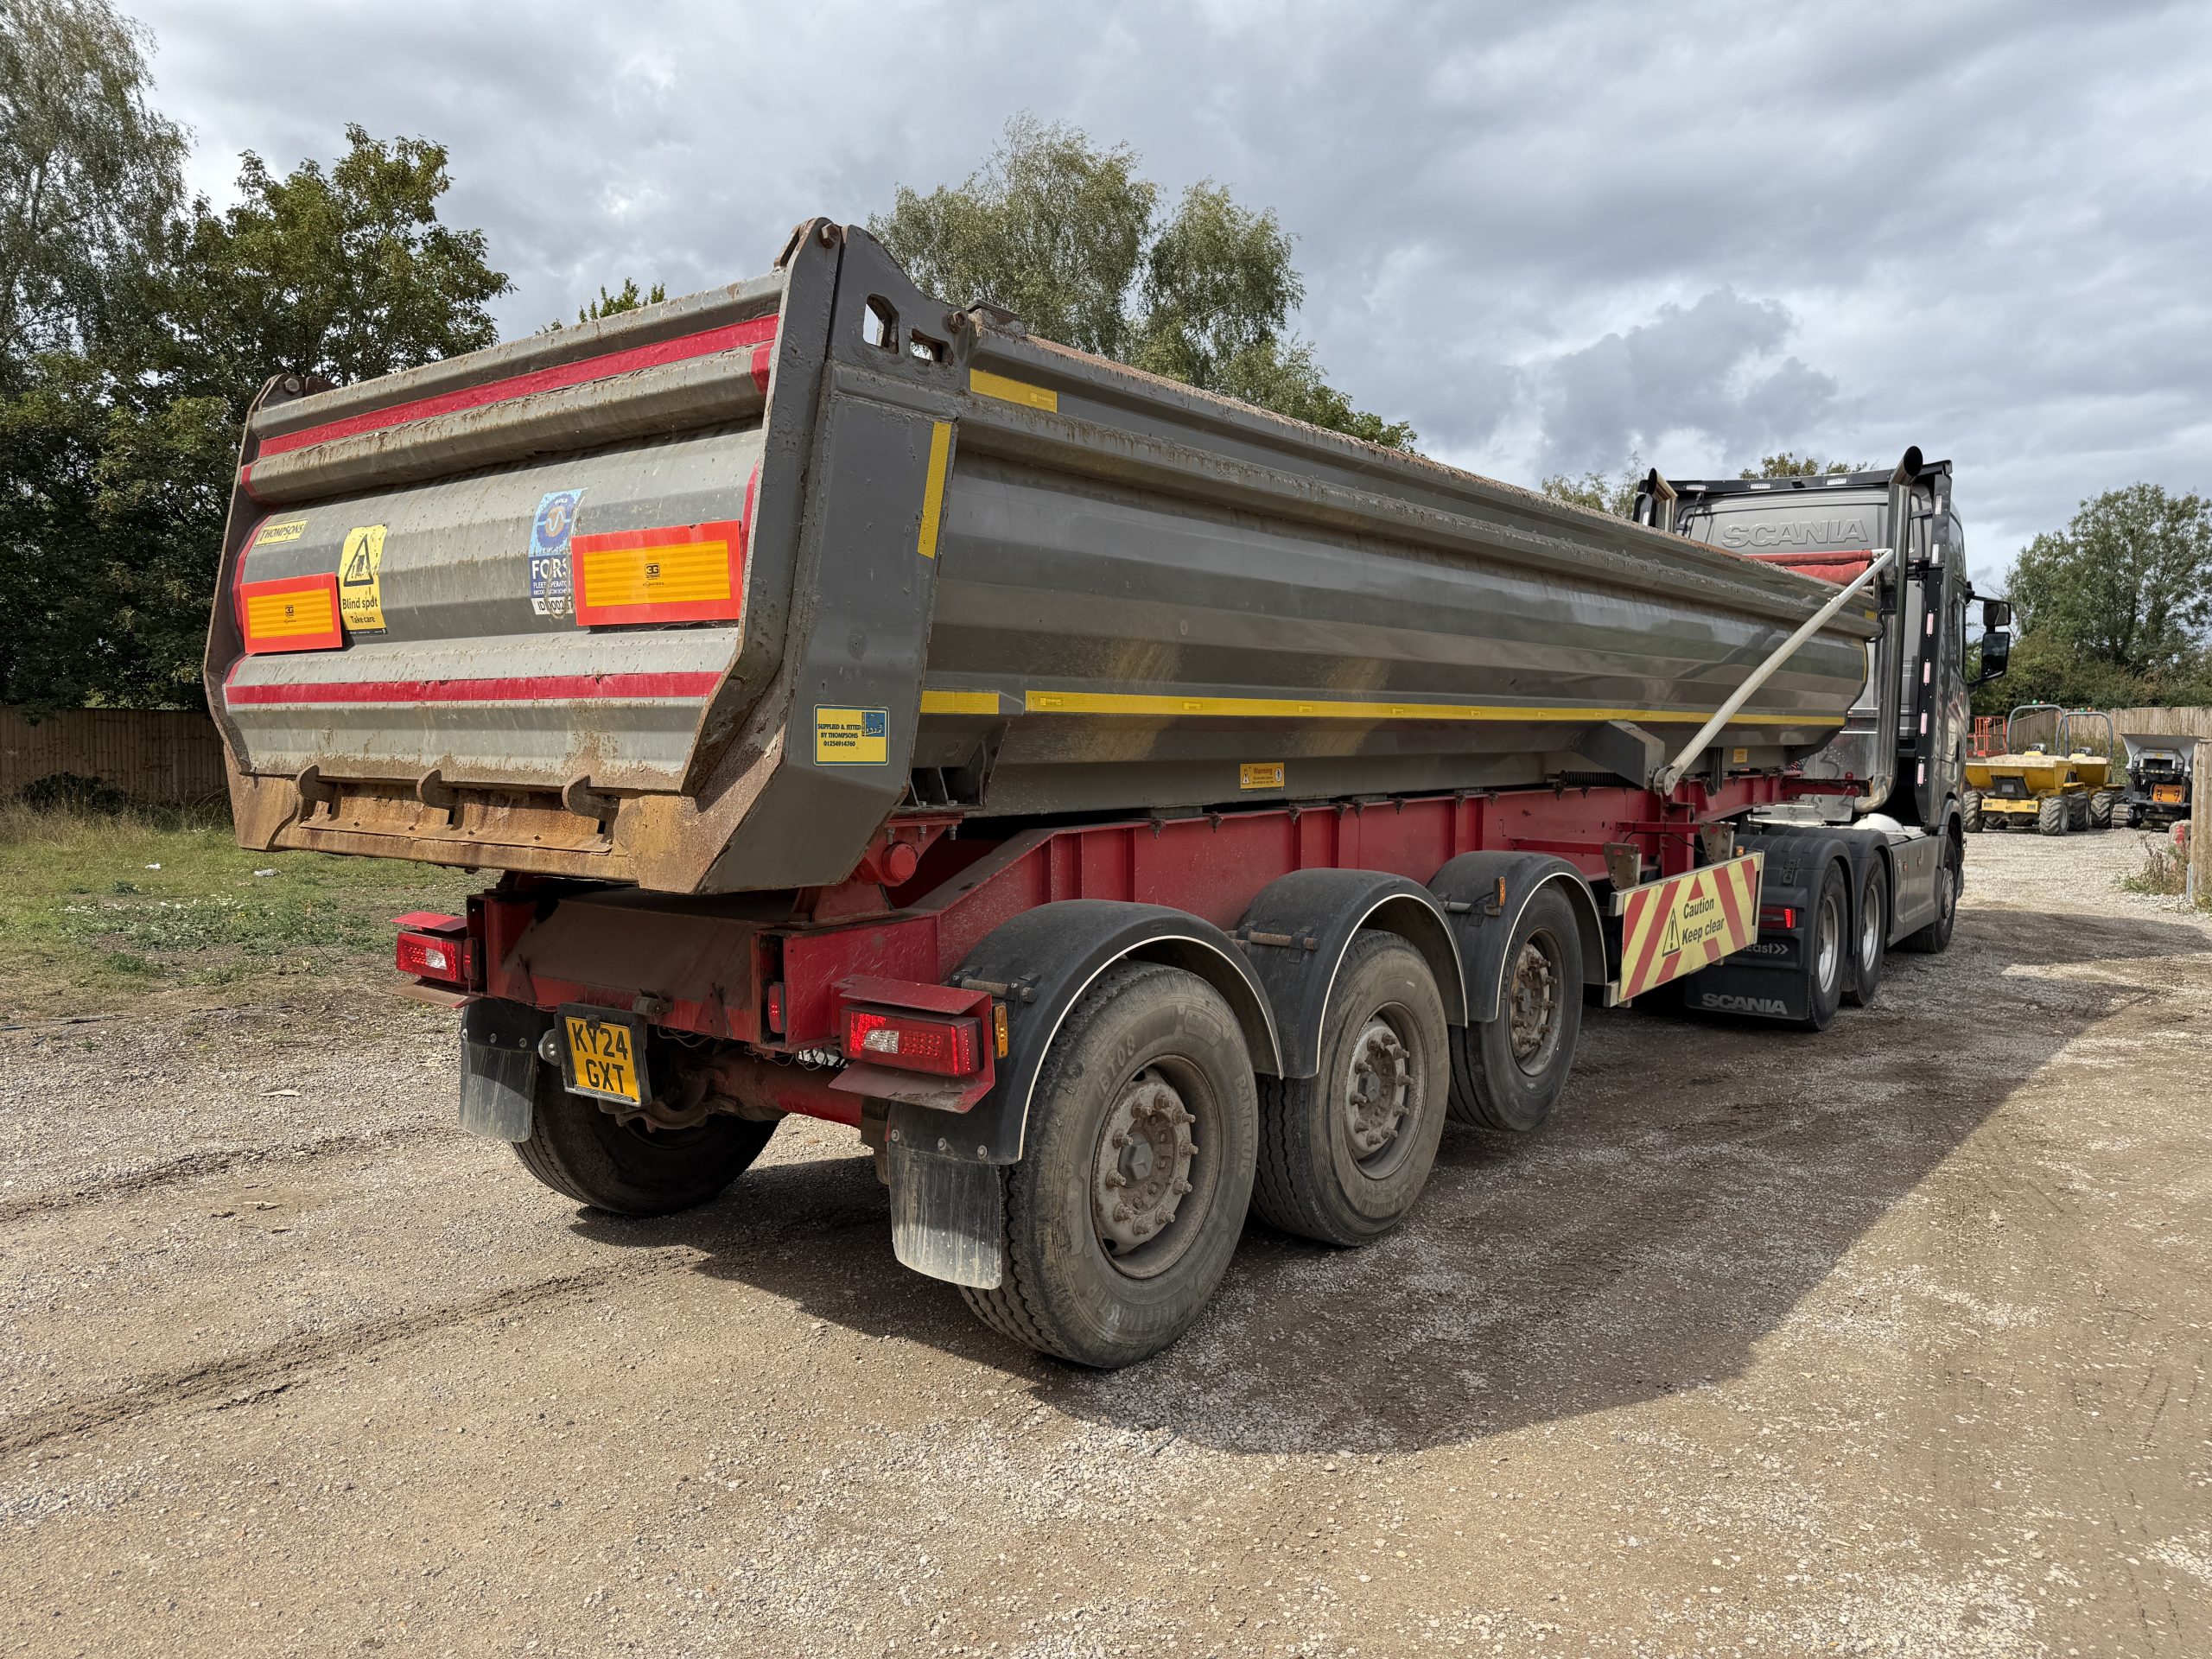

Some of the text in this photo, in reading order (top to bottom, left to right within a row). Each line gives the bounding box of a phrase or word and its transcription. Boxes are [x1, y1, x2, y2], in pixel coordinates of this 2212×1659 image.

[259, 524, 304, 541] THOMPSONS
[1722, 518, 1868, 548] SCANIA
[646, 564, 660, 575] 3G
[342, 596, 378, 611] Blind spot
[1253, 766, 1273, 776] Warning
[1683, 897, 1714, 919] Caution
[1681, 918, 1725, 945] Keep clear
[1744, 943, 1773, 954] East
[1701, 993, 1788, 1014] SCANIA
[572, 1023, 628, 1060] KY24
[585, 1058, 625, 1093] GXT
